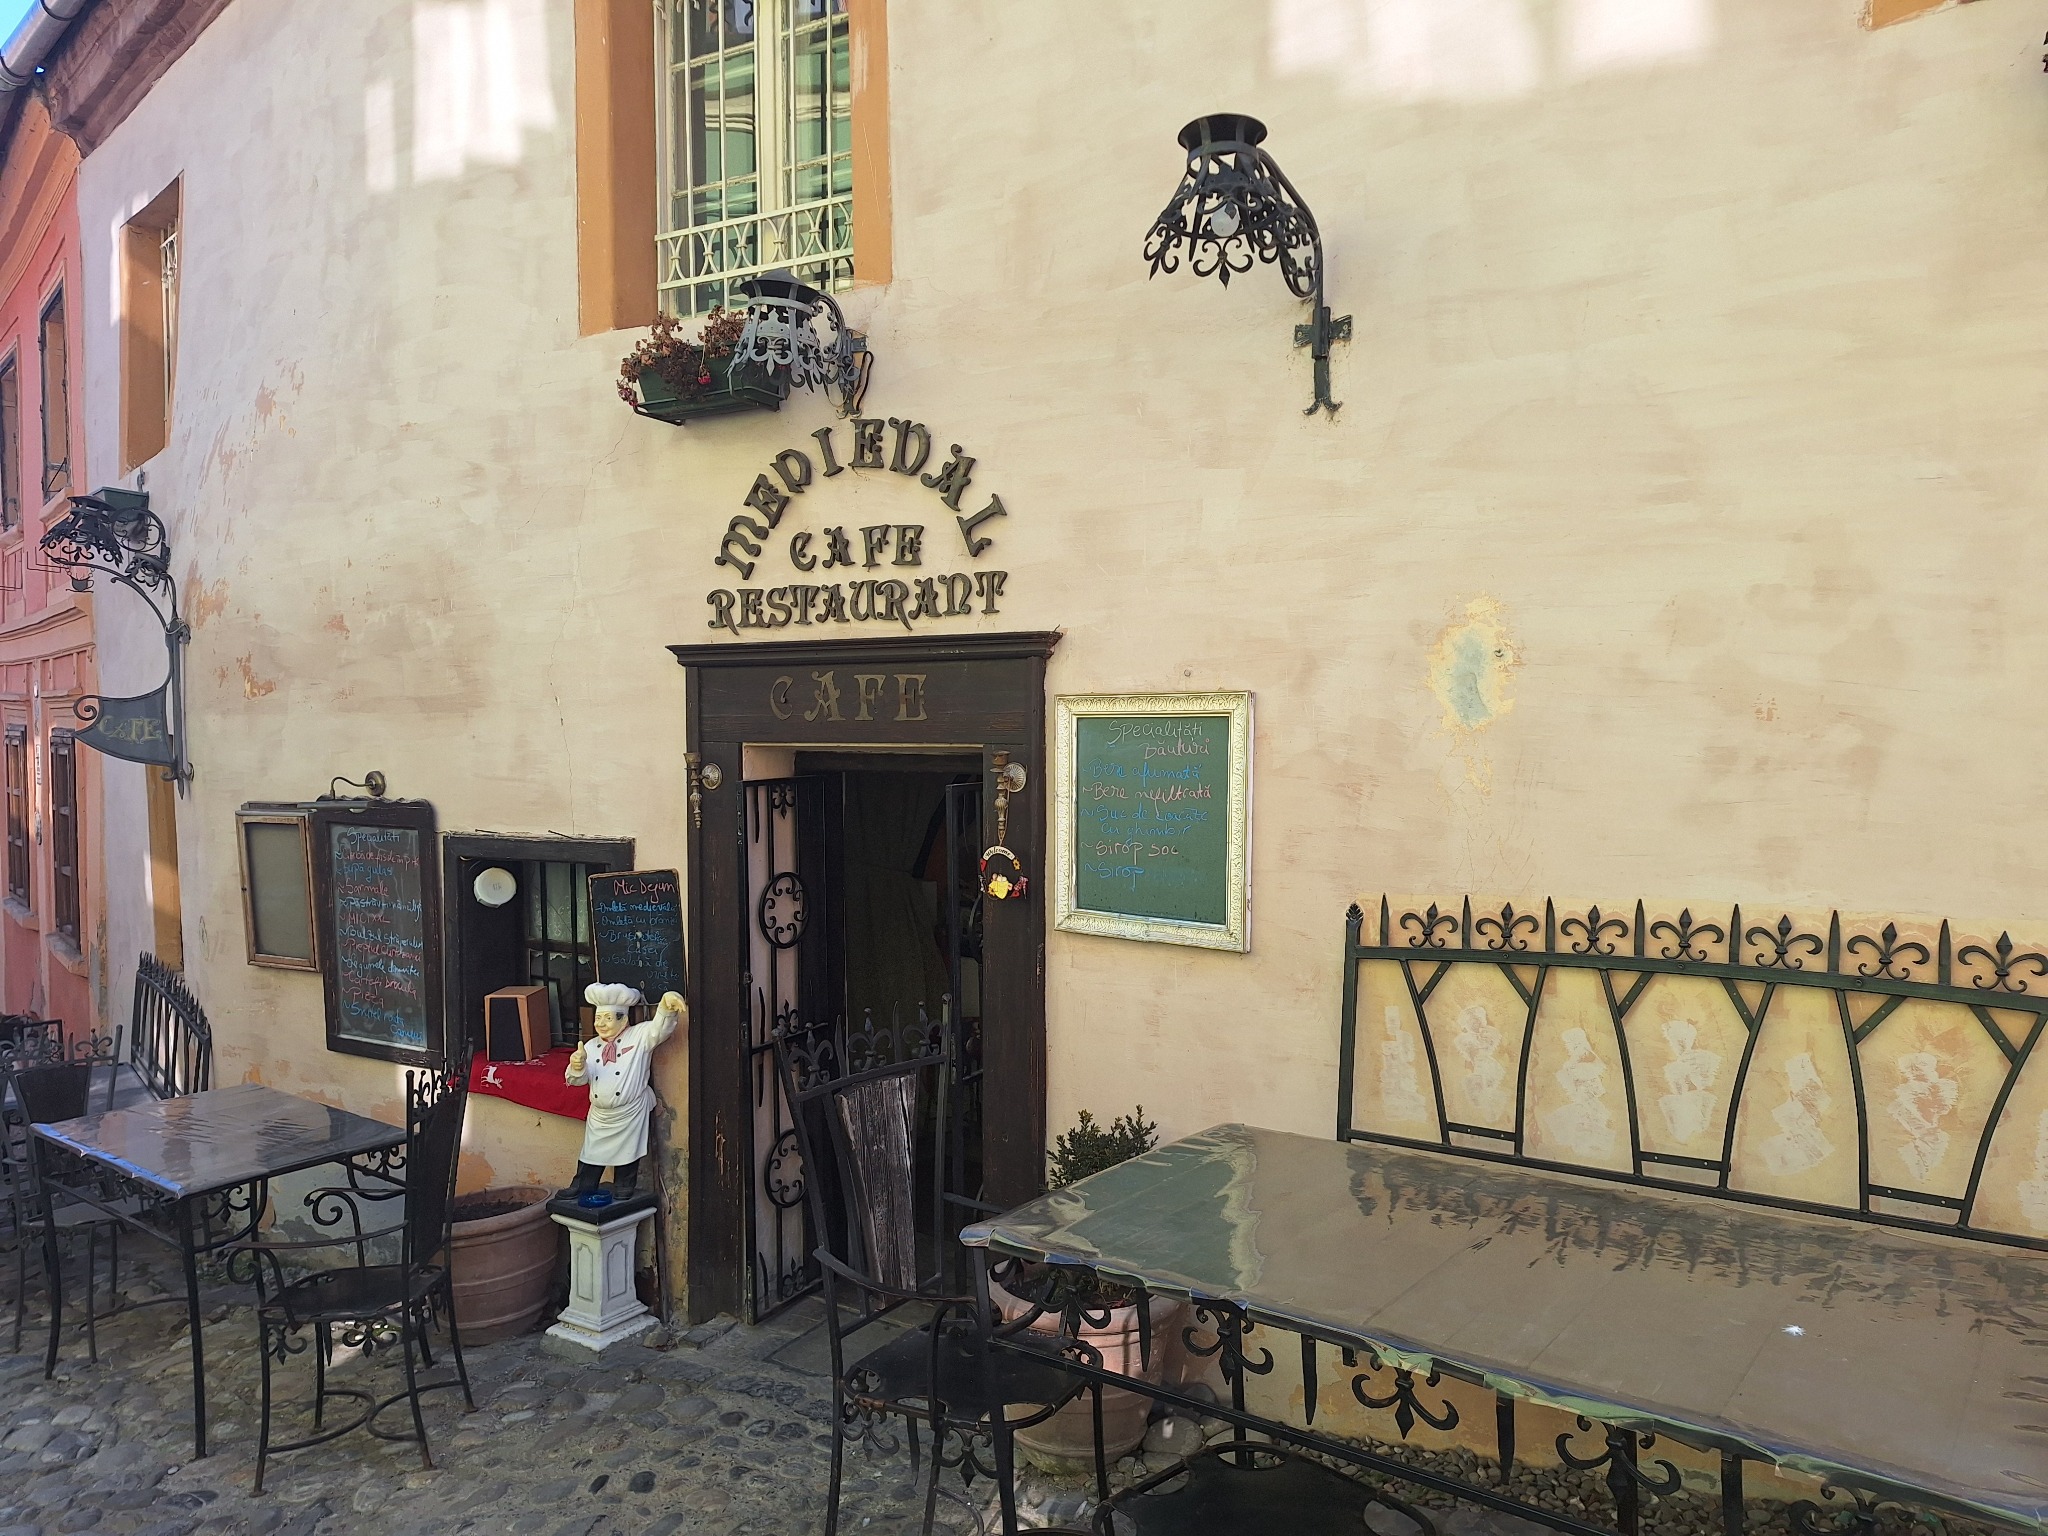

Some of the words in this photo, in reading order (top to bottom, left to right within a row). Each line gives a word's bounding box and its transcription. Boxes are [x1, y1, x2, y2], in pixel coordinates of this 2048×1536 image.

[789, 524, 925, 572] CAFE
[706, 570, 1008, 636] RESTAURANT
[769, 670, 928, 721] CAFE
[98, 714, 163, 743] CAFE
[1091, 781, 1129, 801] Bere
[613, 879, 638, 896] Mic
